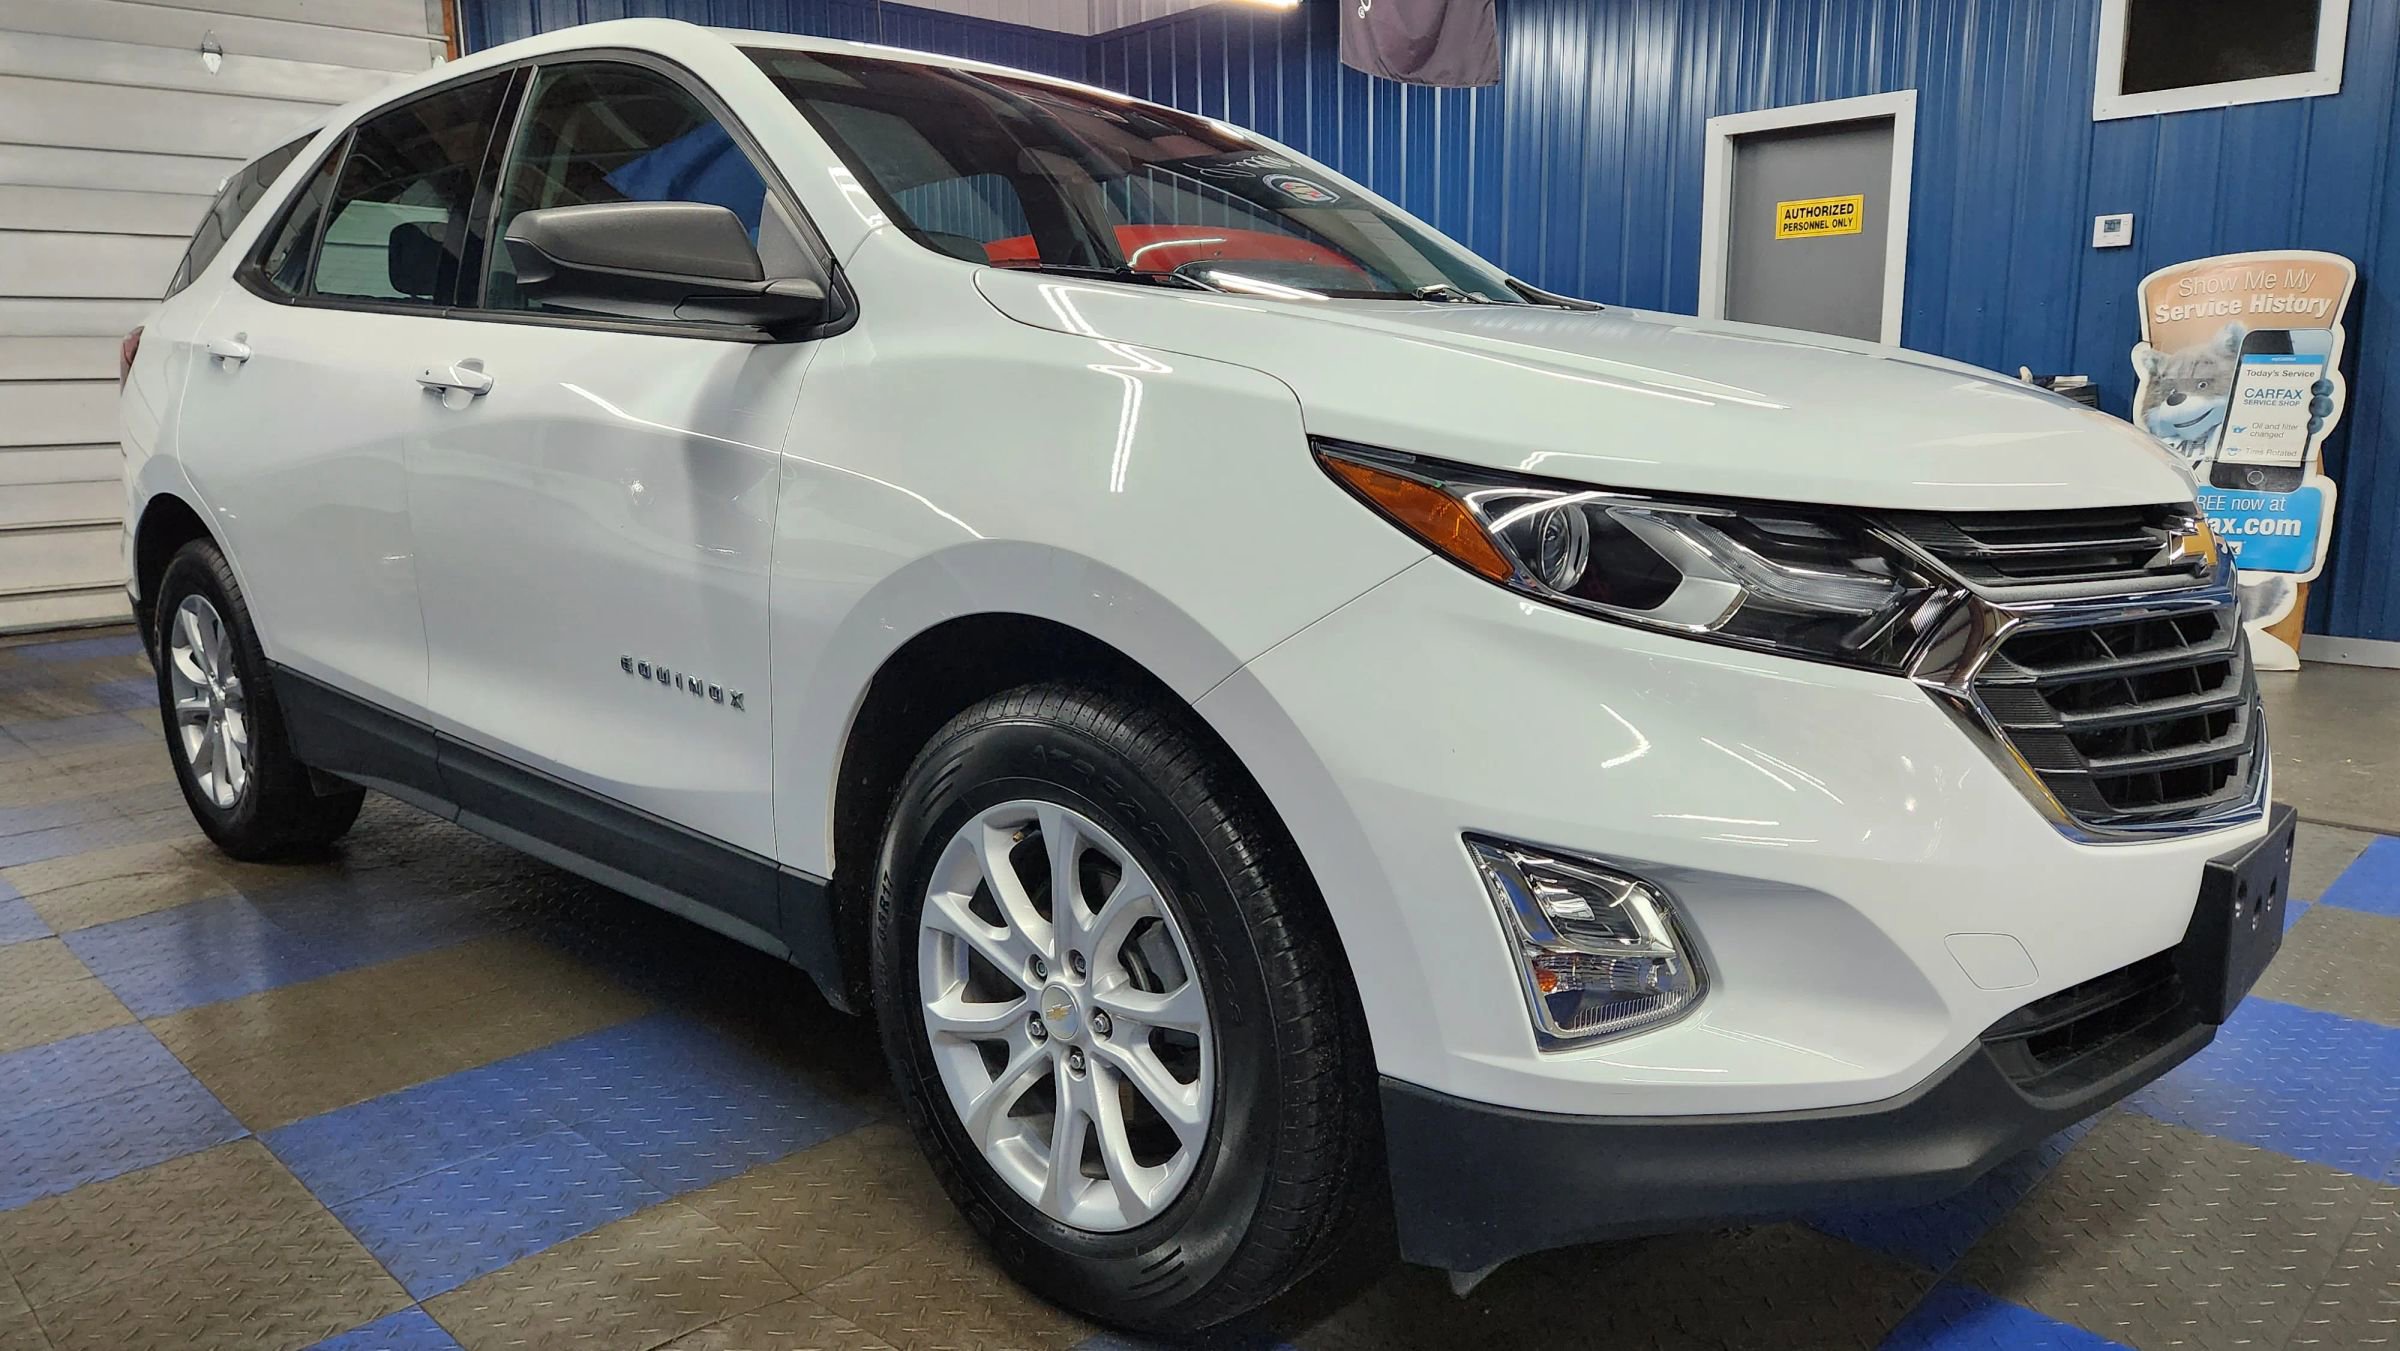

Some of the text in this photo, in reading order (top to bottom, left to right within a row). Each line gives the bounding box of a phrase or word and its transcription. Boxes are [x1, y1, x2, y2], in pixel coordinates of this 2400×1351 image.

[1784, 203, 1855, 220] AUTHORIZED
[1783, 217, 1853, 232] PERSONNEL ONLY
[2178, 268, 2317, 298] Show Me My
[2155, 293, 2333, 325] Service History
[2246, 369, 2315, 378] Today's Service
[2244, 387, 2304, 400] CARFAX
[2195, 495, 2287, 512] REE now at
[620, 654, 745, 712] EQUINOX
